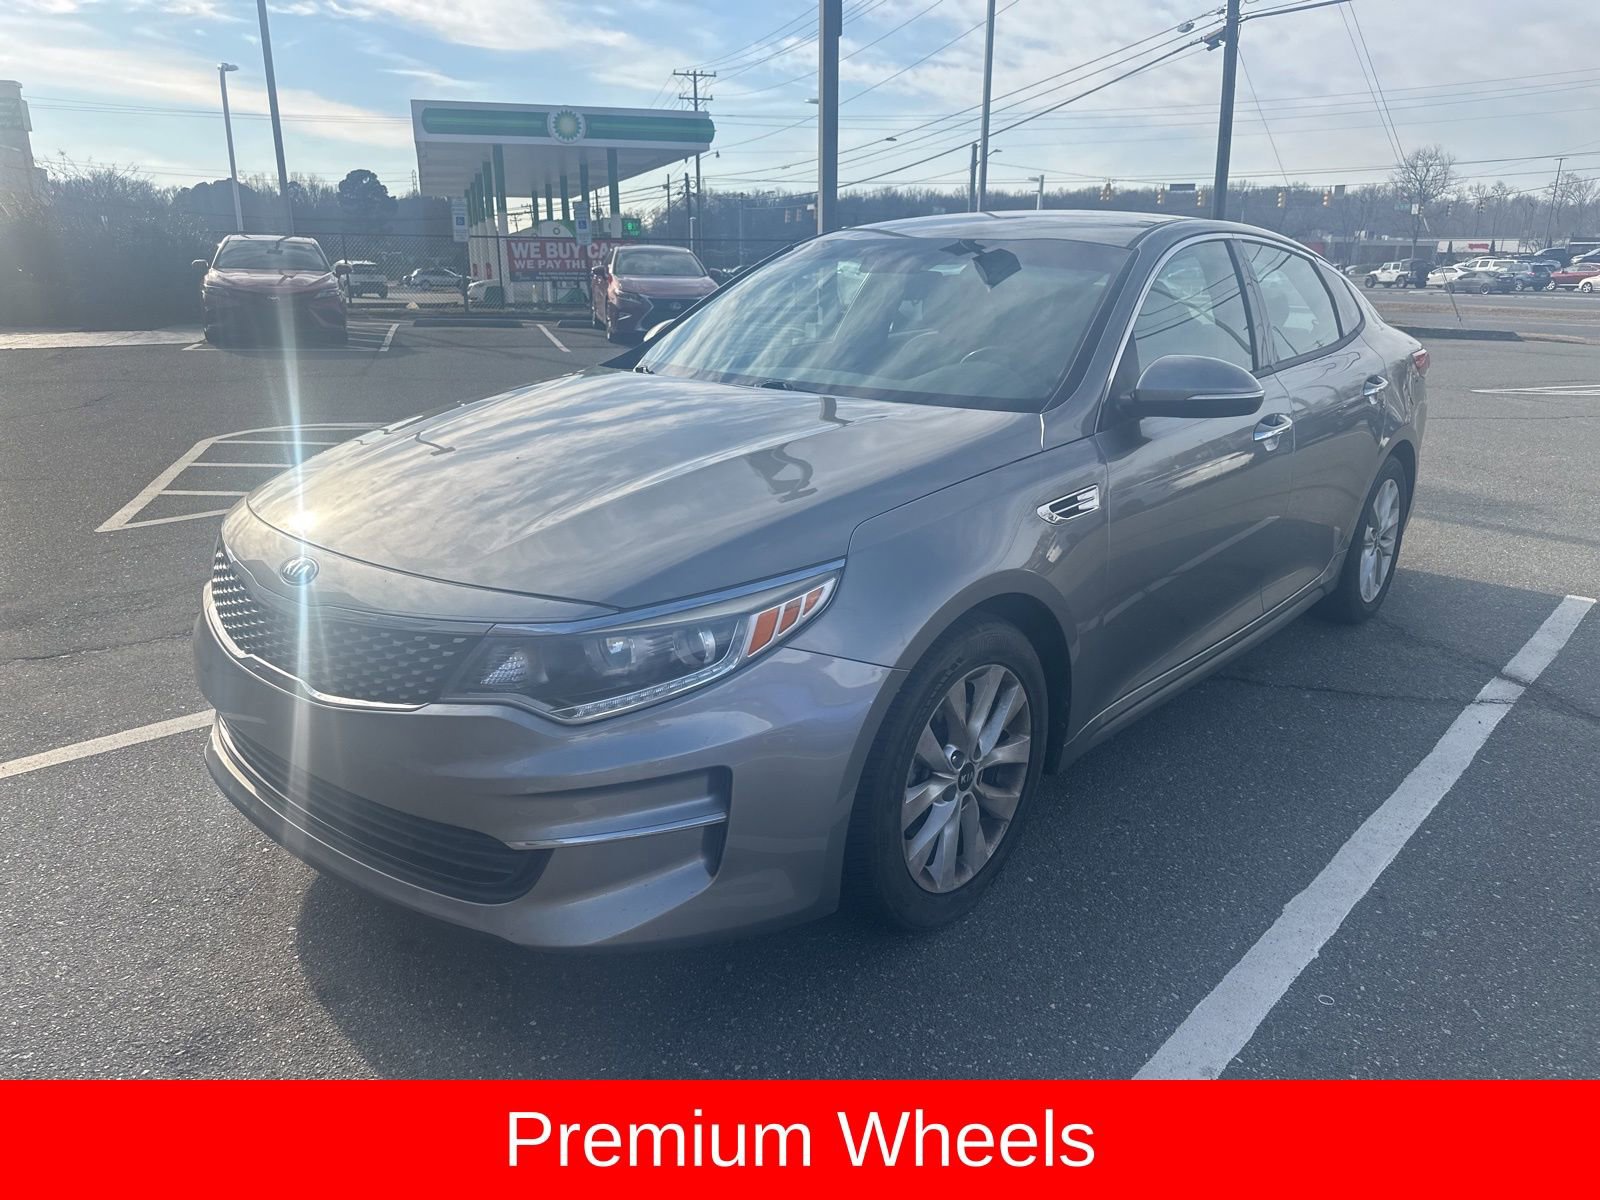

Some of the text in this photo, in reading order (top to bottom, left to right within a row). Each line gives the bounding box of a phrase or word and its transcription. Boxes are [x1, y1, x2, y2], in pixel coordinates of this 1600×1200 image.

[510, 242, 542, 259] WE
[545, 242, 581, 259] BUY
[514, 260, 535, 270] WE
[538, 260, 562, 270] PAY
[283, 559, 311, 577] KIA
[960, 772, 974, 784] KIA
